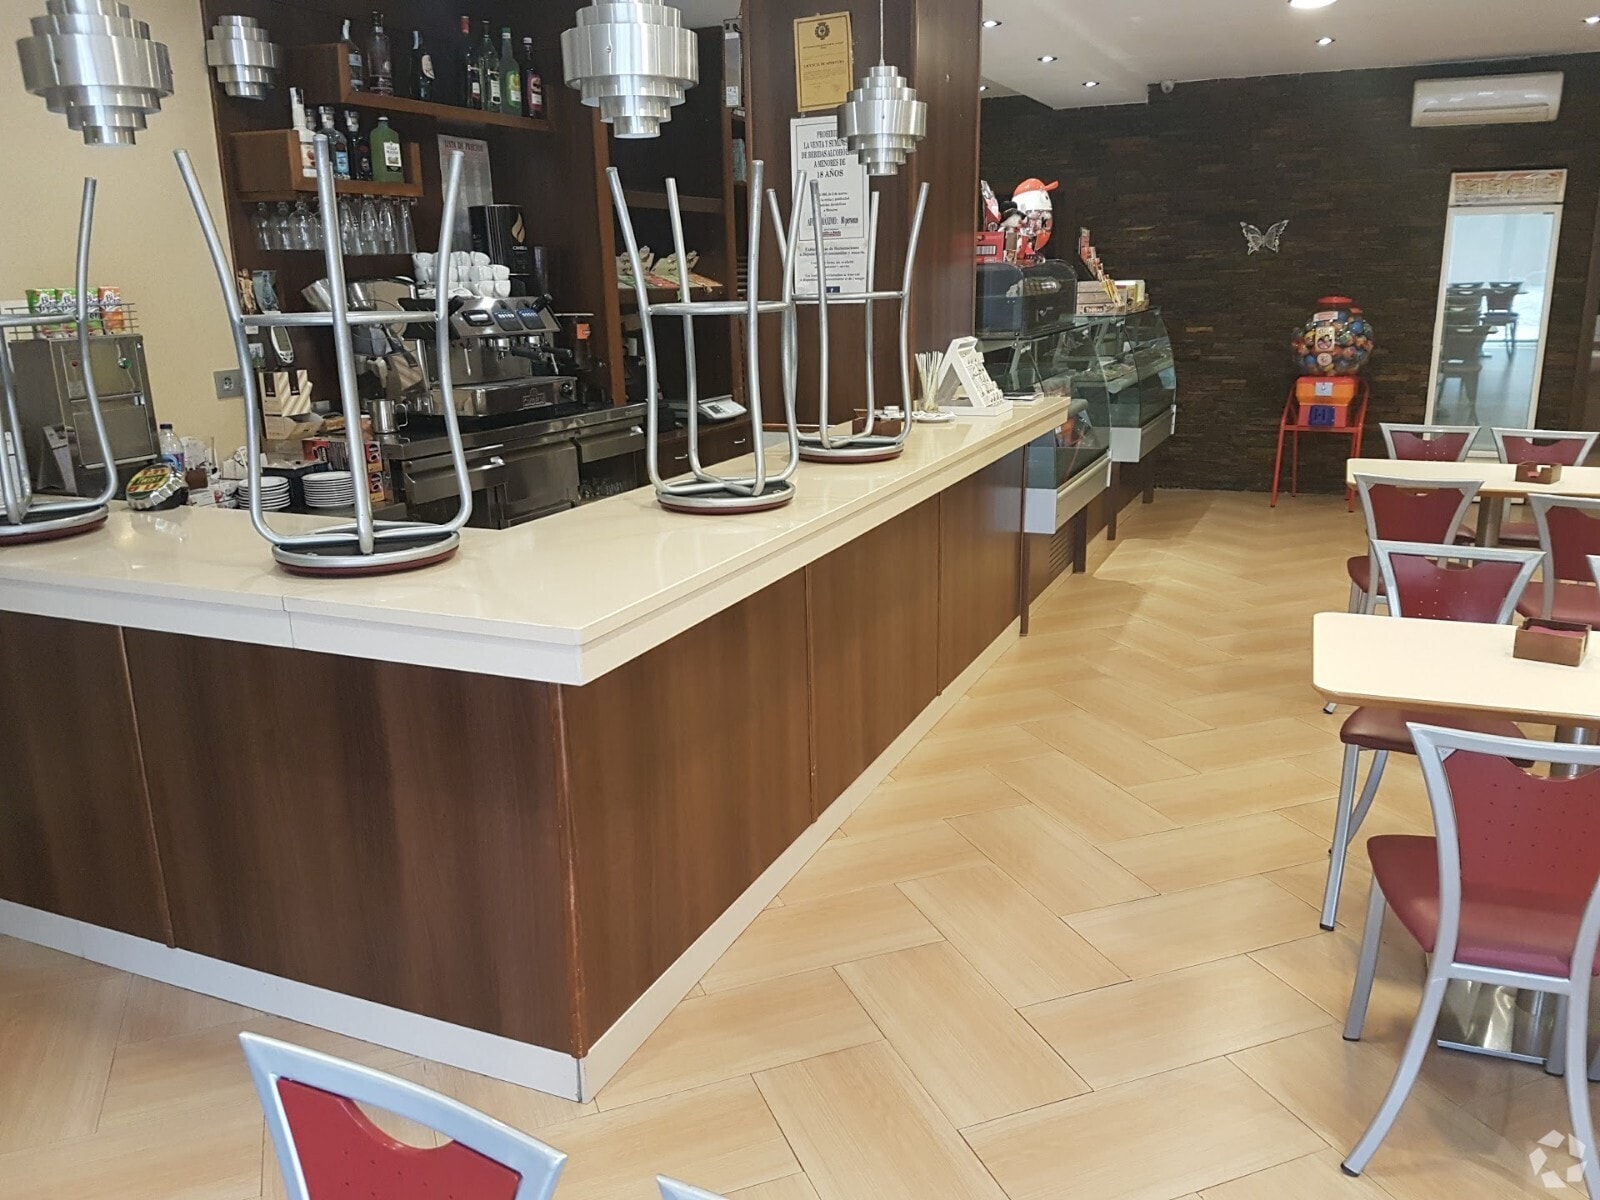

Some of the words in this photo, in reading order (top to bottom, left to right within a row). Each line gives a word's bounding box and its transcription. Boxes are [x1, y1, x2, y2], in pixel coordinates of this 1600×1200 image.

[803, 141, 810, 150] LA
[810, 140, 825, 149] VENTA
[801, 151, 808, 159] DE
[808, 149, 827, 159] BEBIDAS
[817, 158, 839, 168] MENORES
[839, 158, 847, 166] DE
[816, 170, 824, 179] 18
[824, 168, 844, 178] AÑOS
